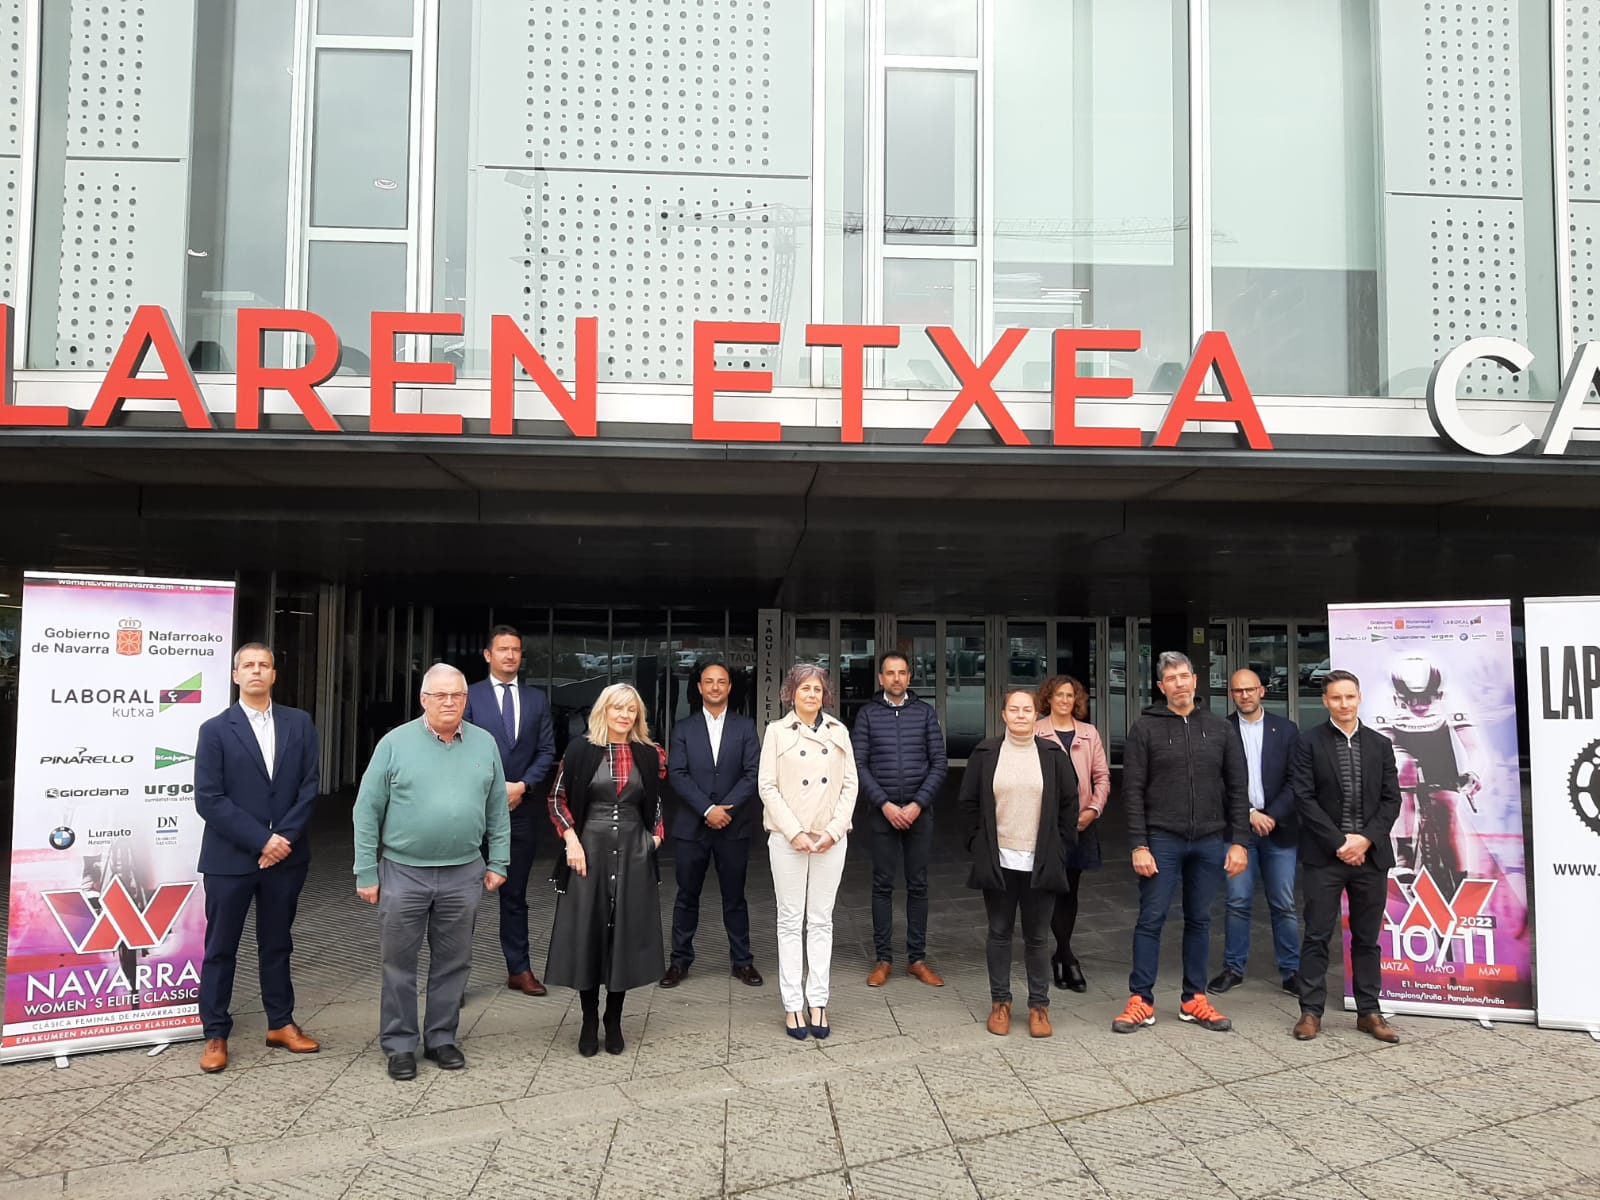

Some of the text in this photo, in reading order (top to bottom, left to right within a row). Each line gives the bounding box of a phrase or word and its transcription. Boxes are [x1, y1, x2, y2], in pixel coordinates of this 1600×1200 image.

[692, 321, 1273, 449] ETXEA
[44, 628, 110, 640] Gobierno
[149, 631, 223, 643] Nafarroako
[32, 643, 110, 655] de Navarra
[149, 645, 215, 657] Gobernua
[51, 688, 154, 704] LABORAL
[112, 707, 154, 718] kutxa
[157, 816, 178, 828] DN
[88, 829, 132, 838] Lurauto
[1553, 863, 1600, 877] www.
[1459, 916, 1493, 928] 2022
[1425, 964, 1456, 974] MAYO
[1478, 967, 1501, 977] MAY
[27, 959, 201, 1001] NAVARRA
[107, 994, 140, 1008] ELITE
[144, 987, 199, 1003] CLASSIC
[32, 1019, 72, 1031] CLÁSICA
[118, 1012, 129, 1021] DE
[132, 1008, 174, 1019] NAVARRA
[176, 1005, 197, 1014] 2022
[16, 1030, 77, 1045] EMAKUMEEN
[80, 1024, 142, 1037] NAFARROAKO
[145, 1018, 187, 1030] KLASIKOA
